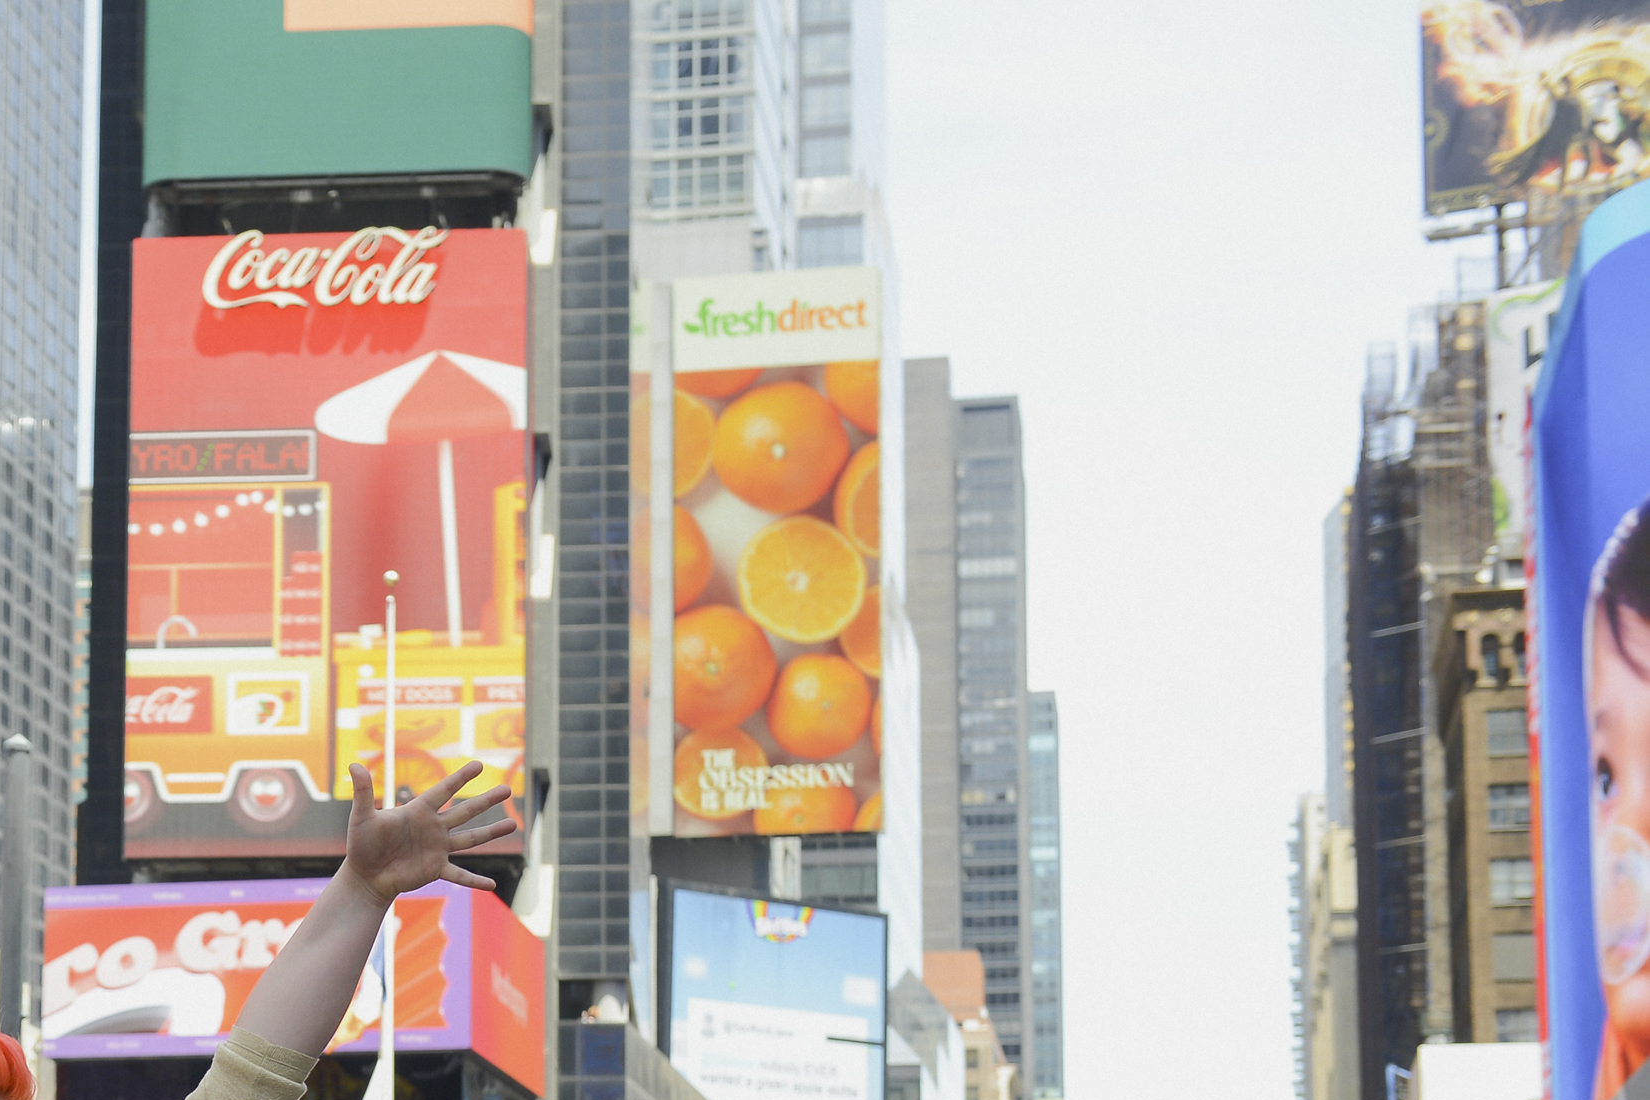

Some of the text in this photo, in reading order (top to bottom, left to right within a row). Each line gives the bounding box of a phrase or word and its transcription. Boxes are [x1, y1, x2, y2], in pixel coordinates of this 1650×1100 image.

[202, 226, 449, 309] Coca-Cola
[697, 298, 867, 337] freshdirect
[405, 687, 453, 702] DOGS
[702, 749, 736, 769] THE
[698, 762, 855, 791] OBSESSION
